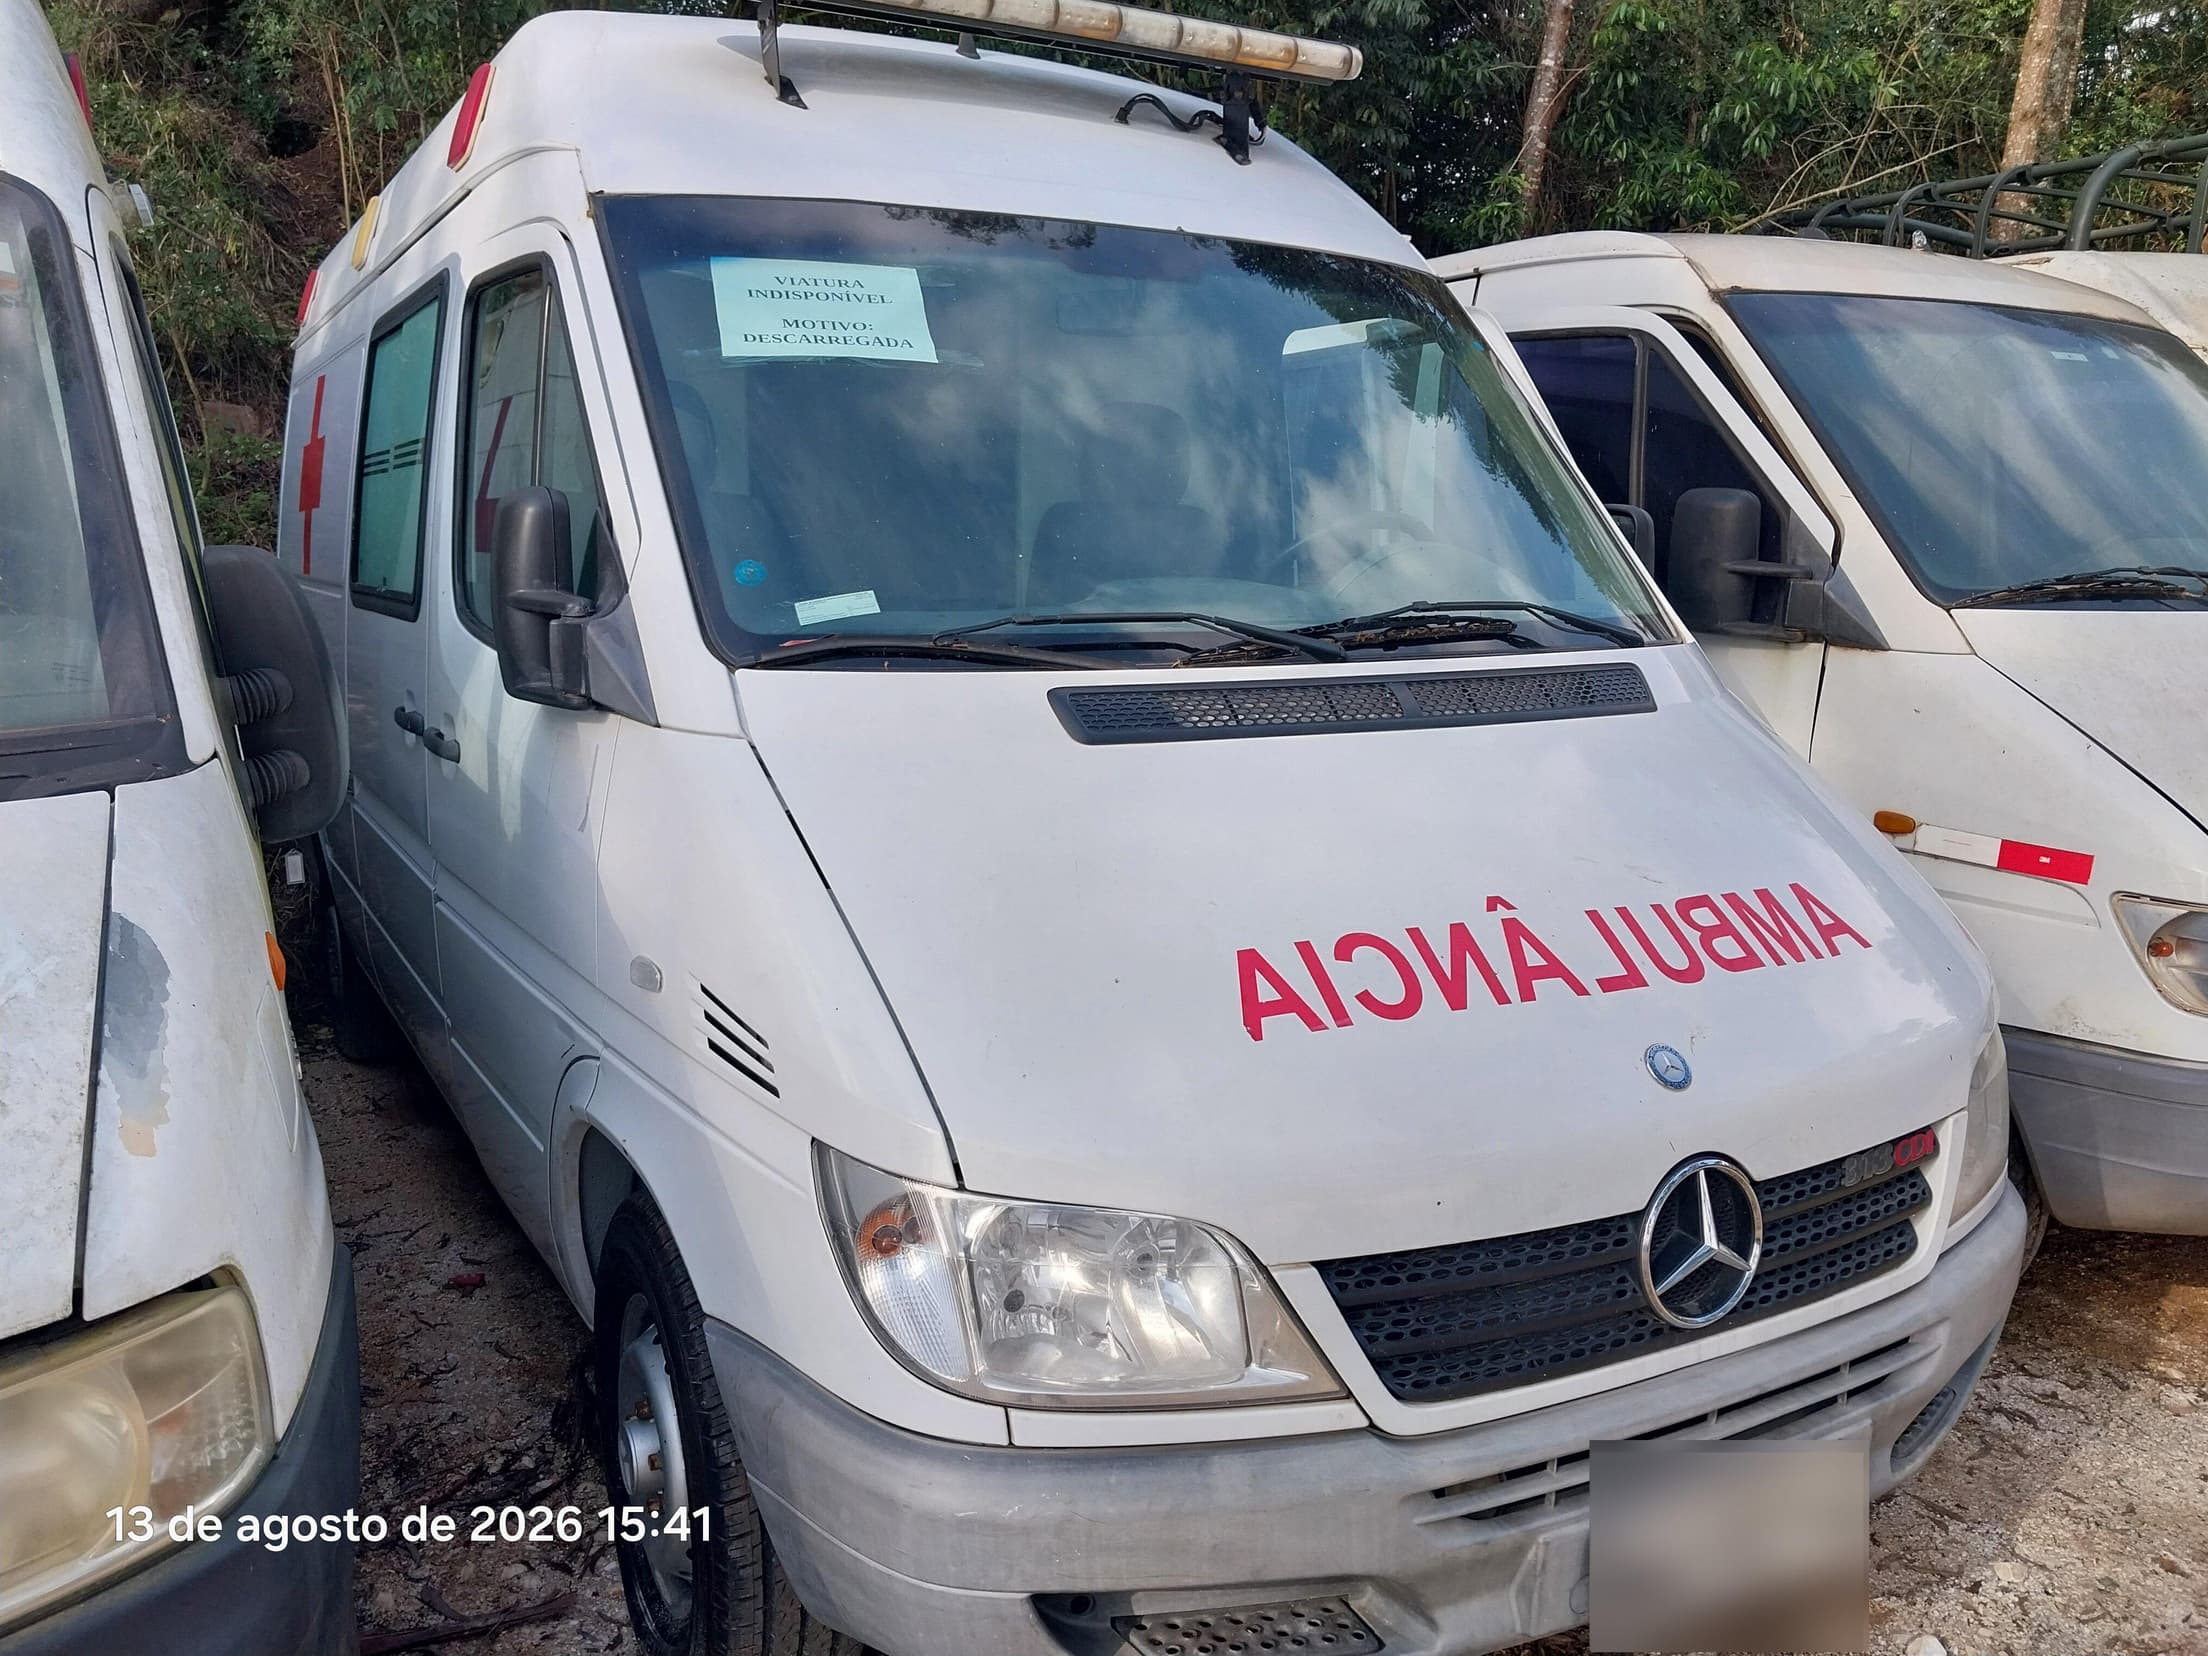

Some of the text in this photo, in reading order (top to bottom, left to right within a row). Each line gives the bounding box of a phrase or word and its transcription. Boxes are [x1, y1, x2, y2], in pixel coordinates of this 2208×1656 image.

[774, 276, 865, 288] VIATURA
[748, 289, 892, 304] INDISPONÍVEL
[782, 318, 873, 331] MOTIVO:
[744, 333, 914, 348] DESCARREGADA
[1895, 1128, 1934, 1166] CDI
